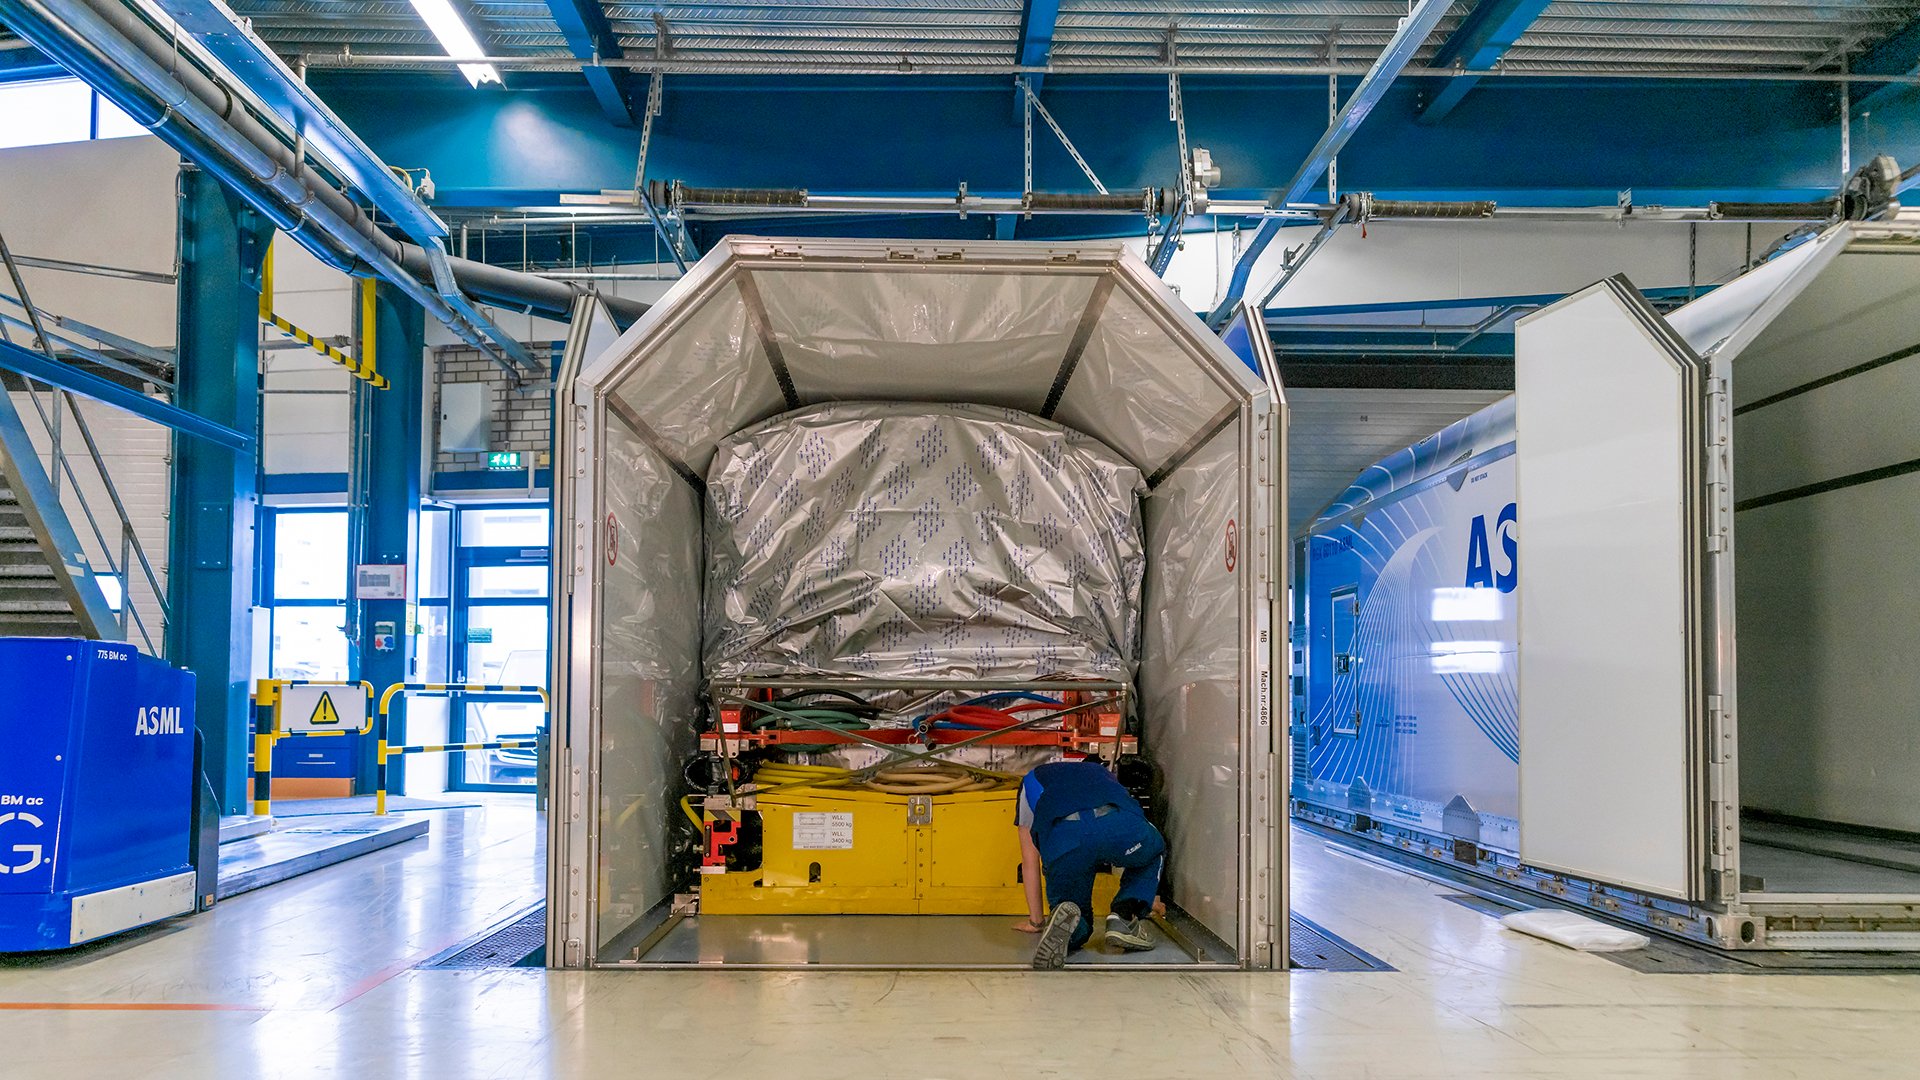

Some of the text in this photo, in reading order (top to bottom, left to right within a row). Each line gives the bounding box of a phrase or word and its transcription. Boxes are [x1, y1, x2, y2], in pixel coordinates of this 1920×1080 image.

[1260, 630, 1267, 643] MB
[97, 649, 128, 661] 775 BM ac
[135, 706, 184, 736] ASML
[0, 794, 44, 806] BM ac
